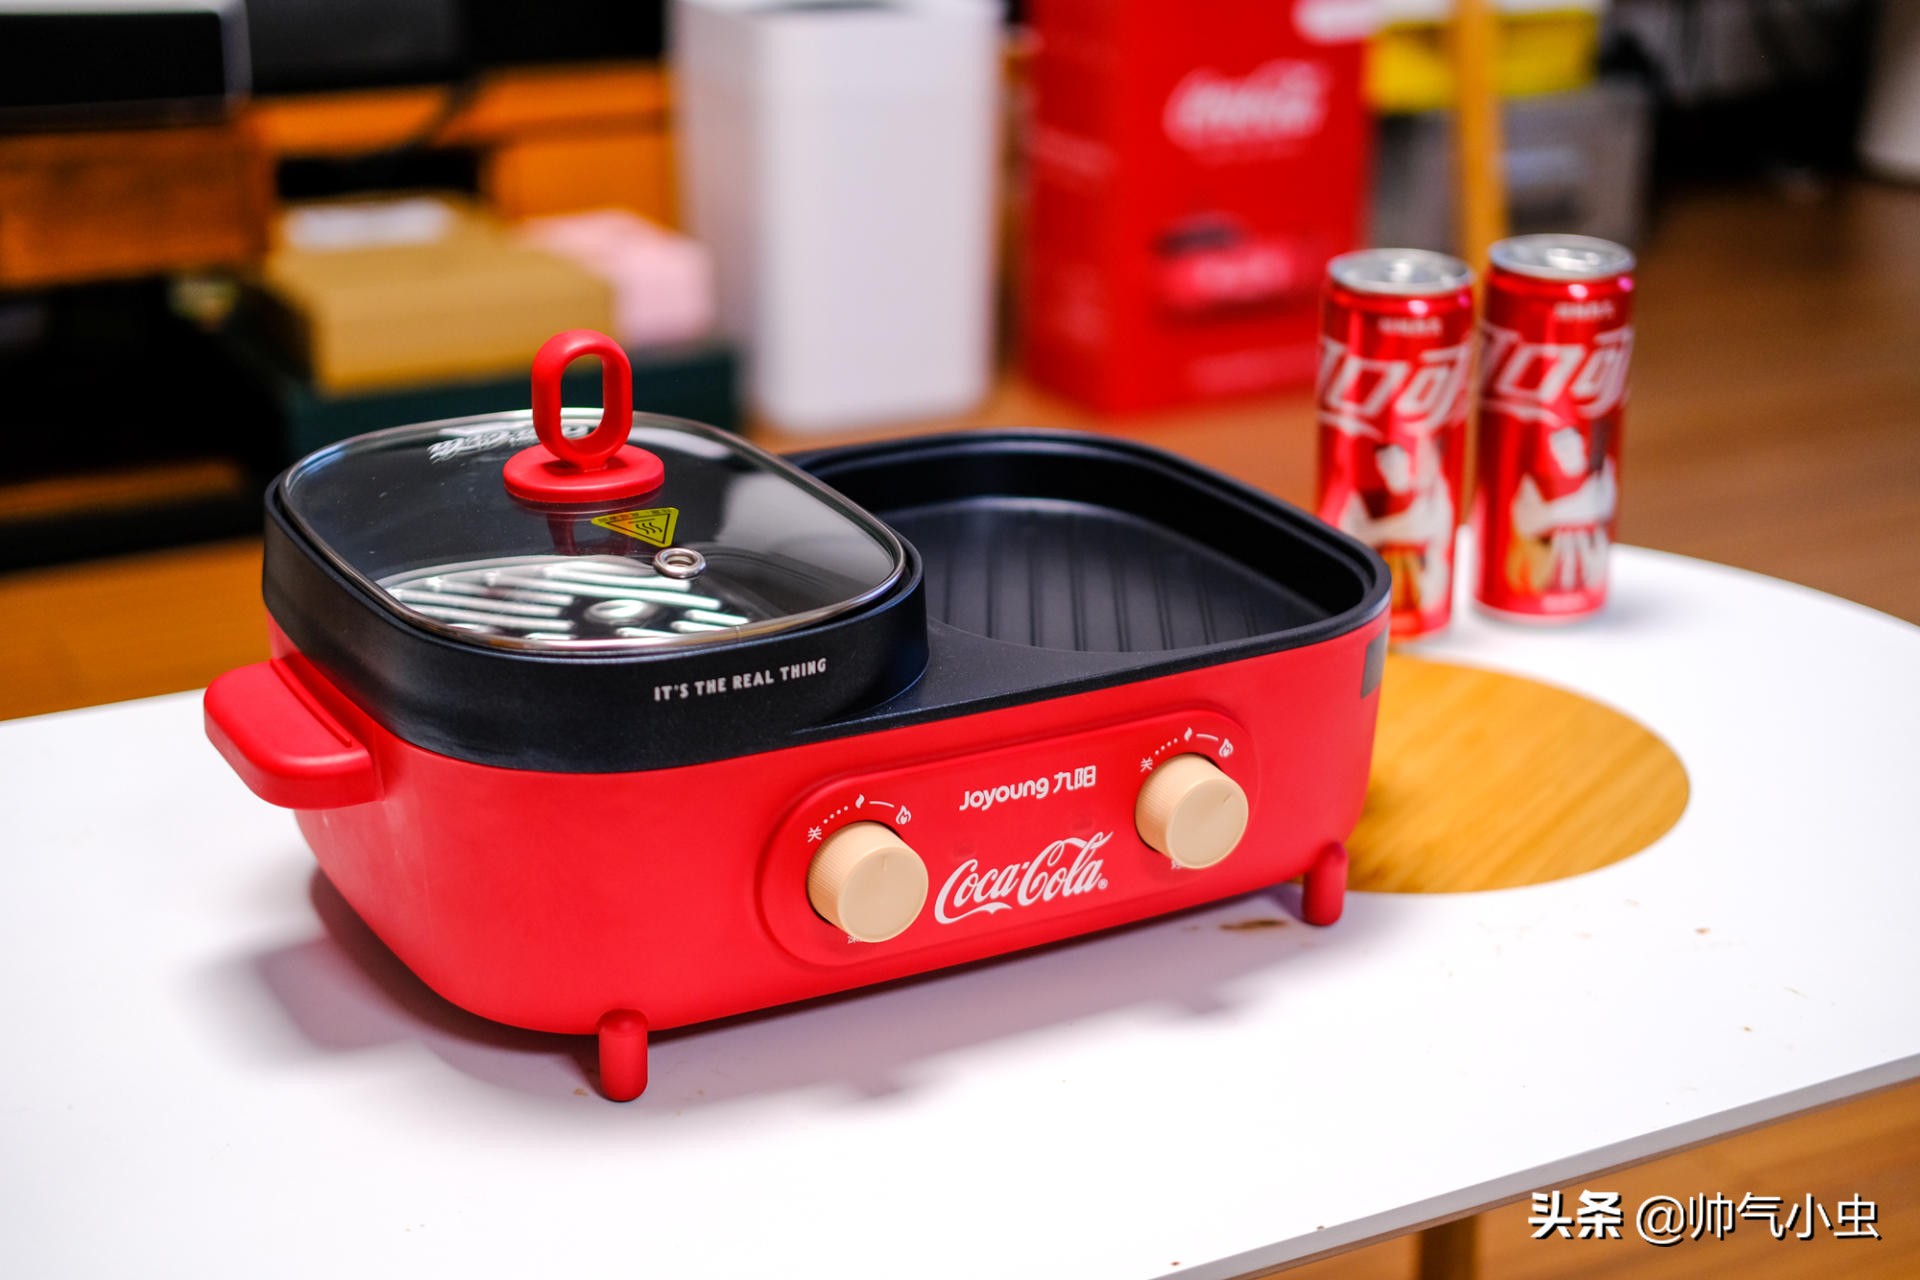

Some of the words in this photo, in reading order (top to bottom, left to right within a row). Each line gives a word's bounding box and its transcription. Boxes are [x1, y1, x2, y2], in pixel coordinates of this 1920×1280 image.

[653, 683, 689, 702] IT'S
[694, 677, 728, 696] THE
[732, 669, 775, 690] REAL
[779, 657, 828, 681] THING
[1139, 756, 1153, 773] 关
[958, 777, 1050, 812] Joyoung
[1052, 764, 1097, 794] 九阳
[807, 825, 822, 843] 关
